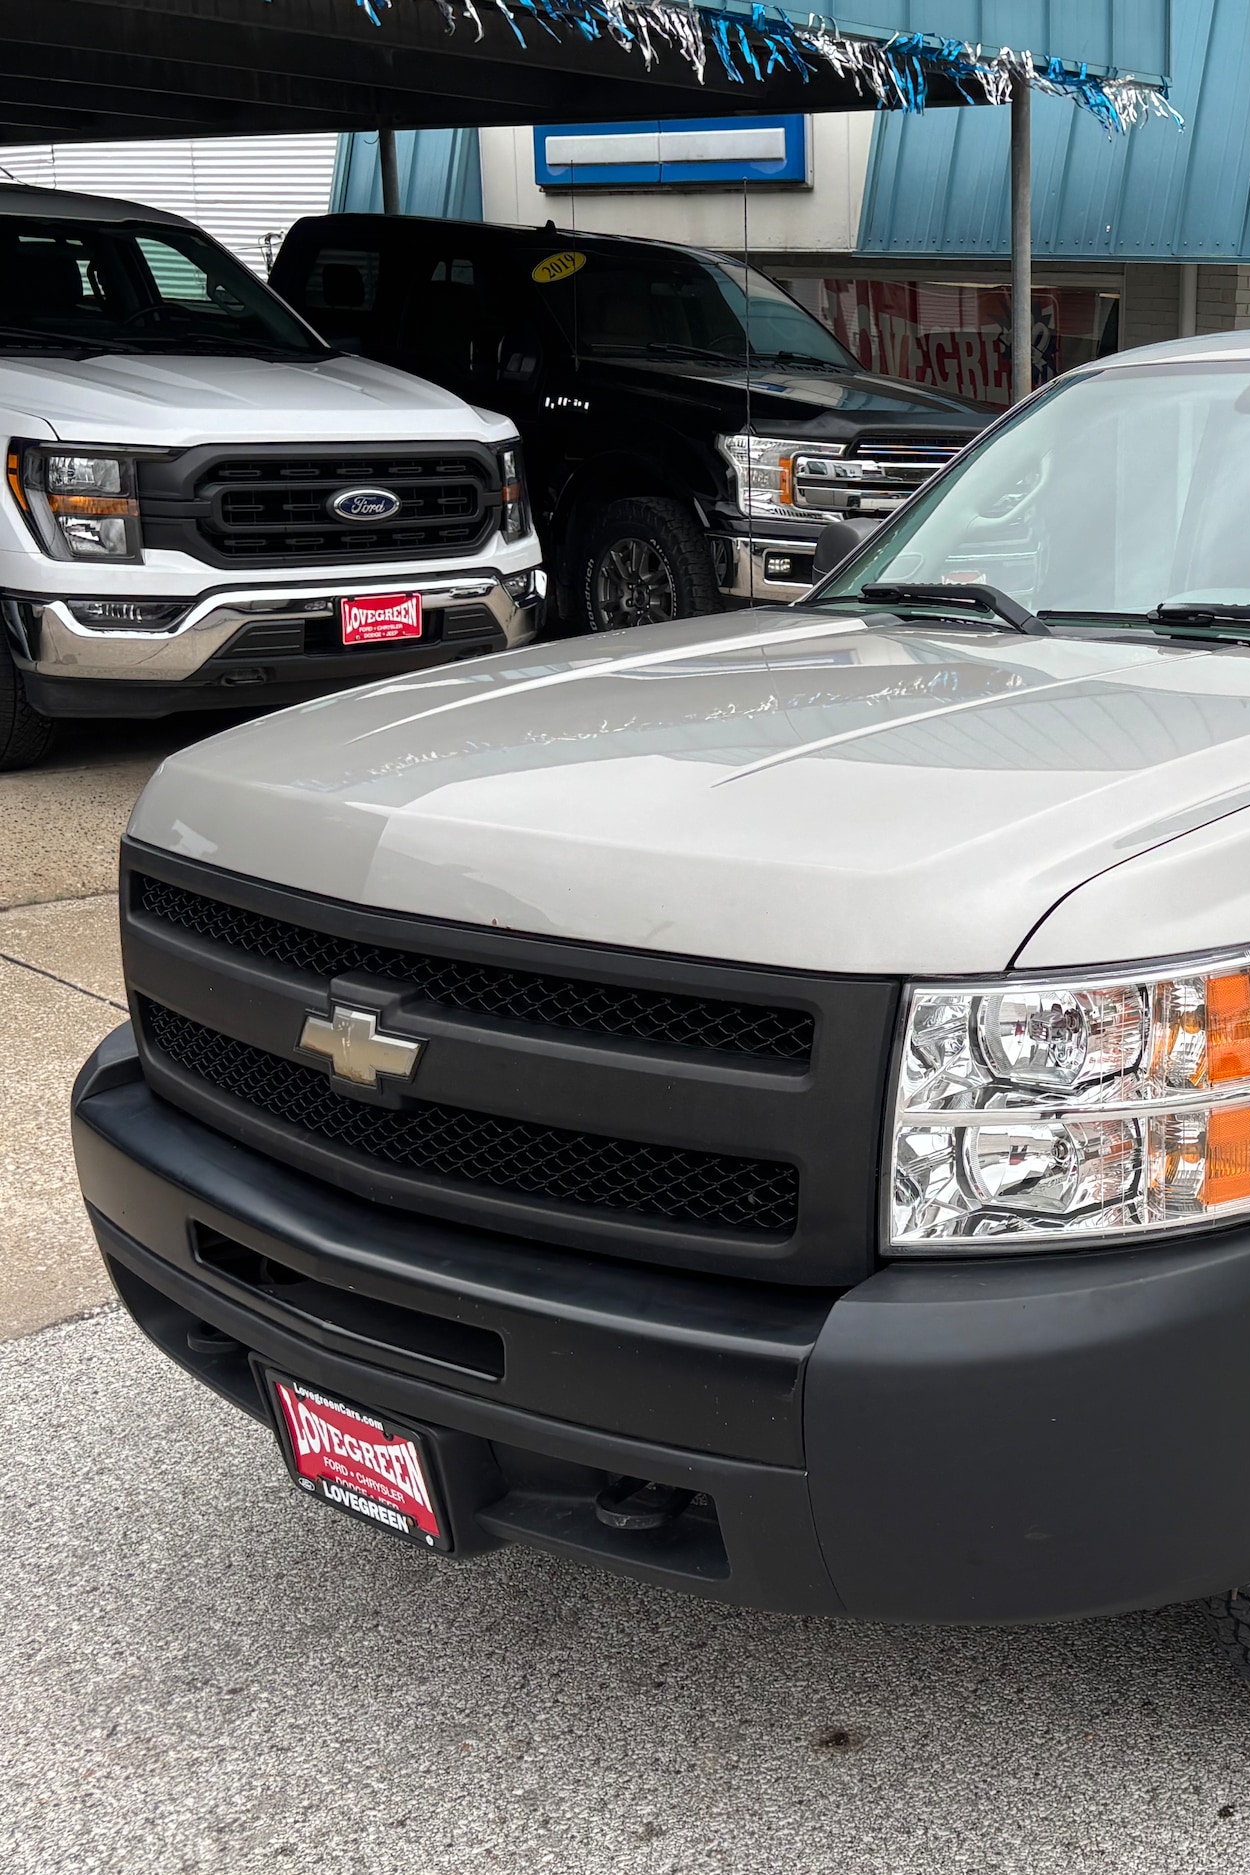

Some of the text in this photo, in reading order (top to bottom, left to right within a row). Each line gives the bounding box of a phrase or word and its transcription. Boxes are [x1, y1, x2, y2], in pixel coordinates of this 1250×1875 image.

[542, 254, 575, 278] 2019
[351, 496, 386, 513] Ford
[344, 597, 417, 635] LOVEGREEN
[377, 623, 403, 631] CHRYSLER
[293, 1382, 385, 1431] LovegreenCars.com
[280, 1384, 433, 1514] LOVEGREEN
[323, 1456, 406, 1504] FORD CHRYSLER
[322, 1480, 410, 1534] LOVEGREEN
